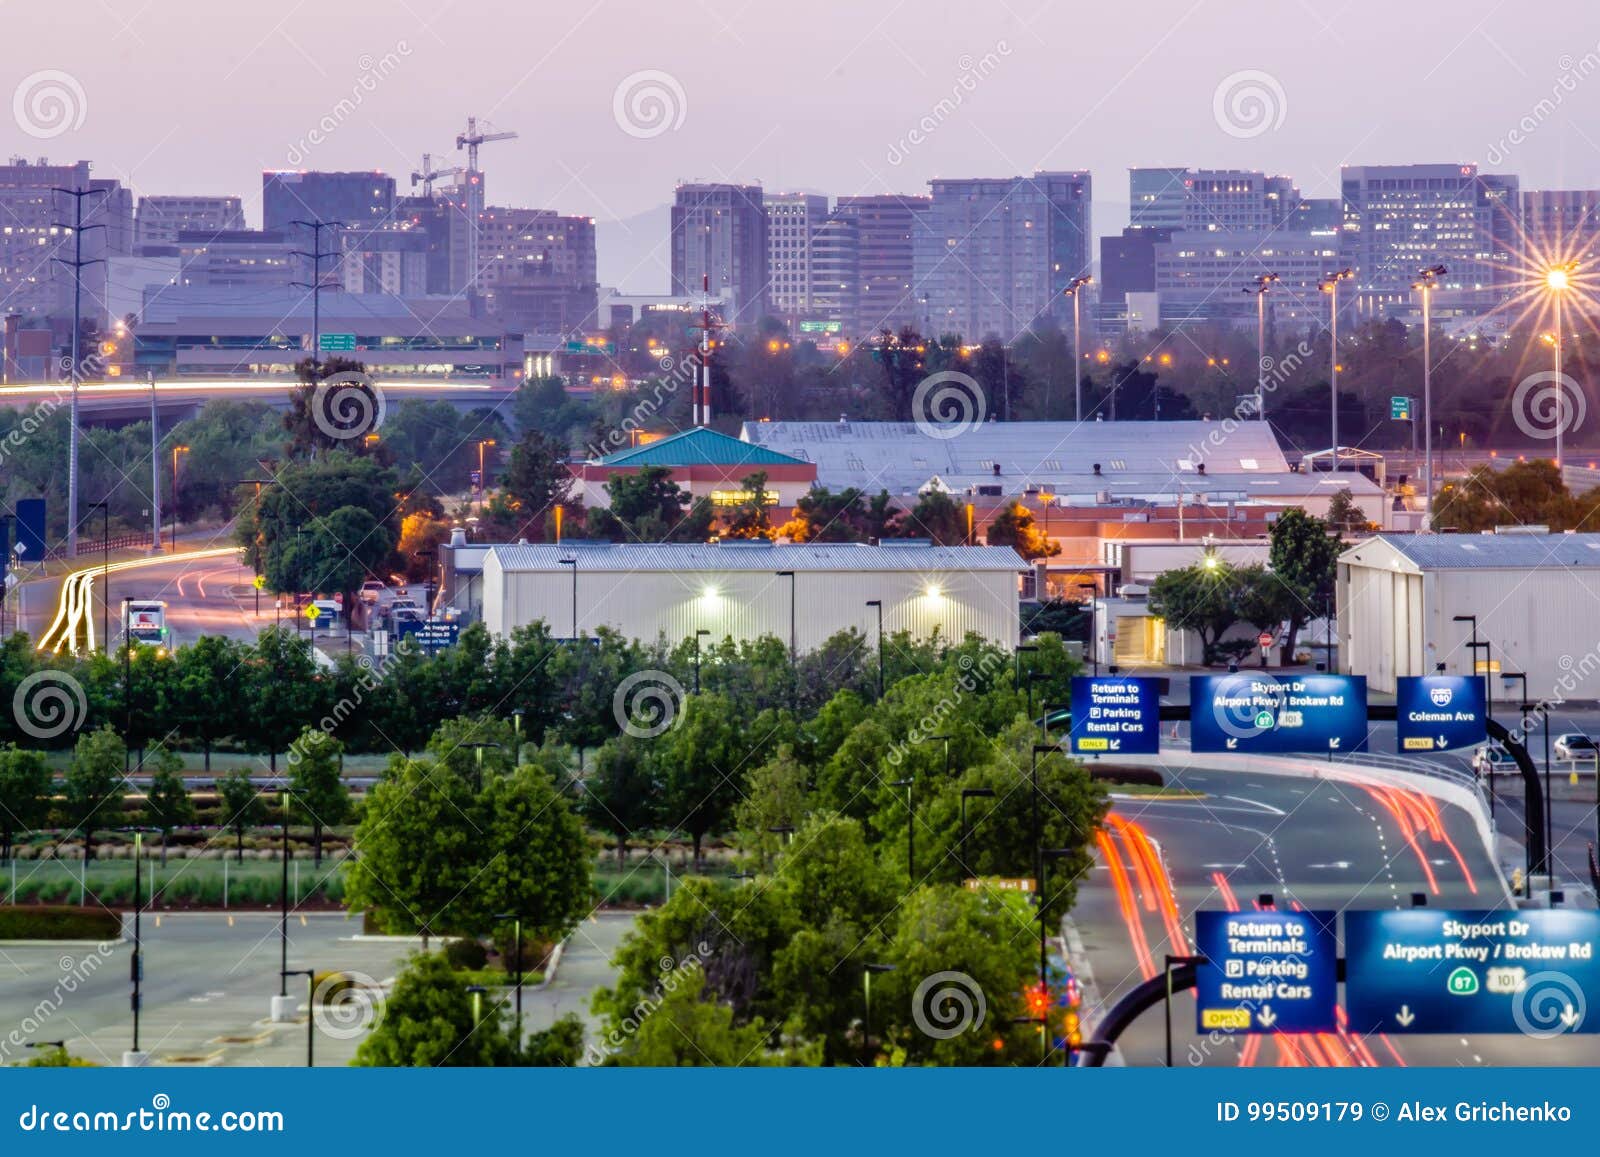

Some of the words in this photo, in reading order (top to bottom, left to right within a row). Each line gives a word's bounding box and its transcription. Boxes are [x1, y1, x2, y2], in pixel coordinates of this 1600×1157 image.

[1091, 684, 1125, 693] Return
[1127, 684, 1139, 693] to
[1251, 682, 1291, 695] Skyport
[1292, 682, 1306, 692] Dr
[1091, 694, 1139, 703] Terminals
[1214, 696, 1251, 708] Airport
[1253, 696, 1280, 708] Pkwy
[1289, 696, 1328, 706] Brokaw
[1329, 696, 1343, 706] Rd
[1103, 708, 1141, 720] Parking
[1285, 715, 1296, 723] 101
[1408, 711, 1453, 721] Coleman
[1455, 711, 1475, 721] Ave
[1087, 722, 1119, 732] Rental
[1121, 722, 1143, 732] Cars
[1228, 921, 1283, 936] Return
[1285, 922, 1304, 936] to
[1442, 920, 1505, 939] Skyport
[1508, 921, 1529, 936] Dr
[1228, 938, 1305, 953] Terminals
[1383, 944, 1442, 962] Airport
[1445, 944, 1489, 962] Pkwy
[1493, 944, 1500, 958] /
[1505, 943, 1566, 959] Brokaw
[1569, 943, 1591, 958] Rd
[1246, 960, 1308, 979] Parking
[1454, 977, 1471, 989] 87
[1498, 975, 1515, 986] 101
[1221, 983, 1273, 999] Rental
[1276, 983, 1312, 998] Cars
